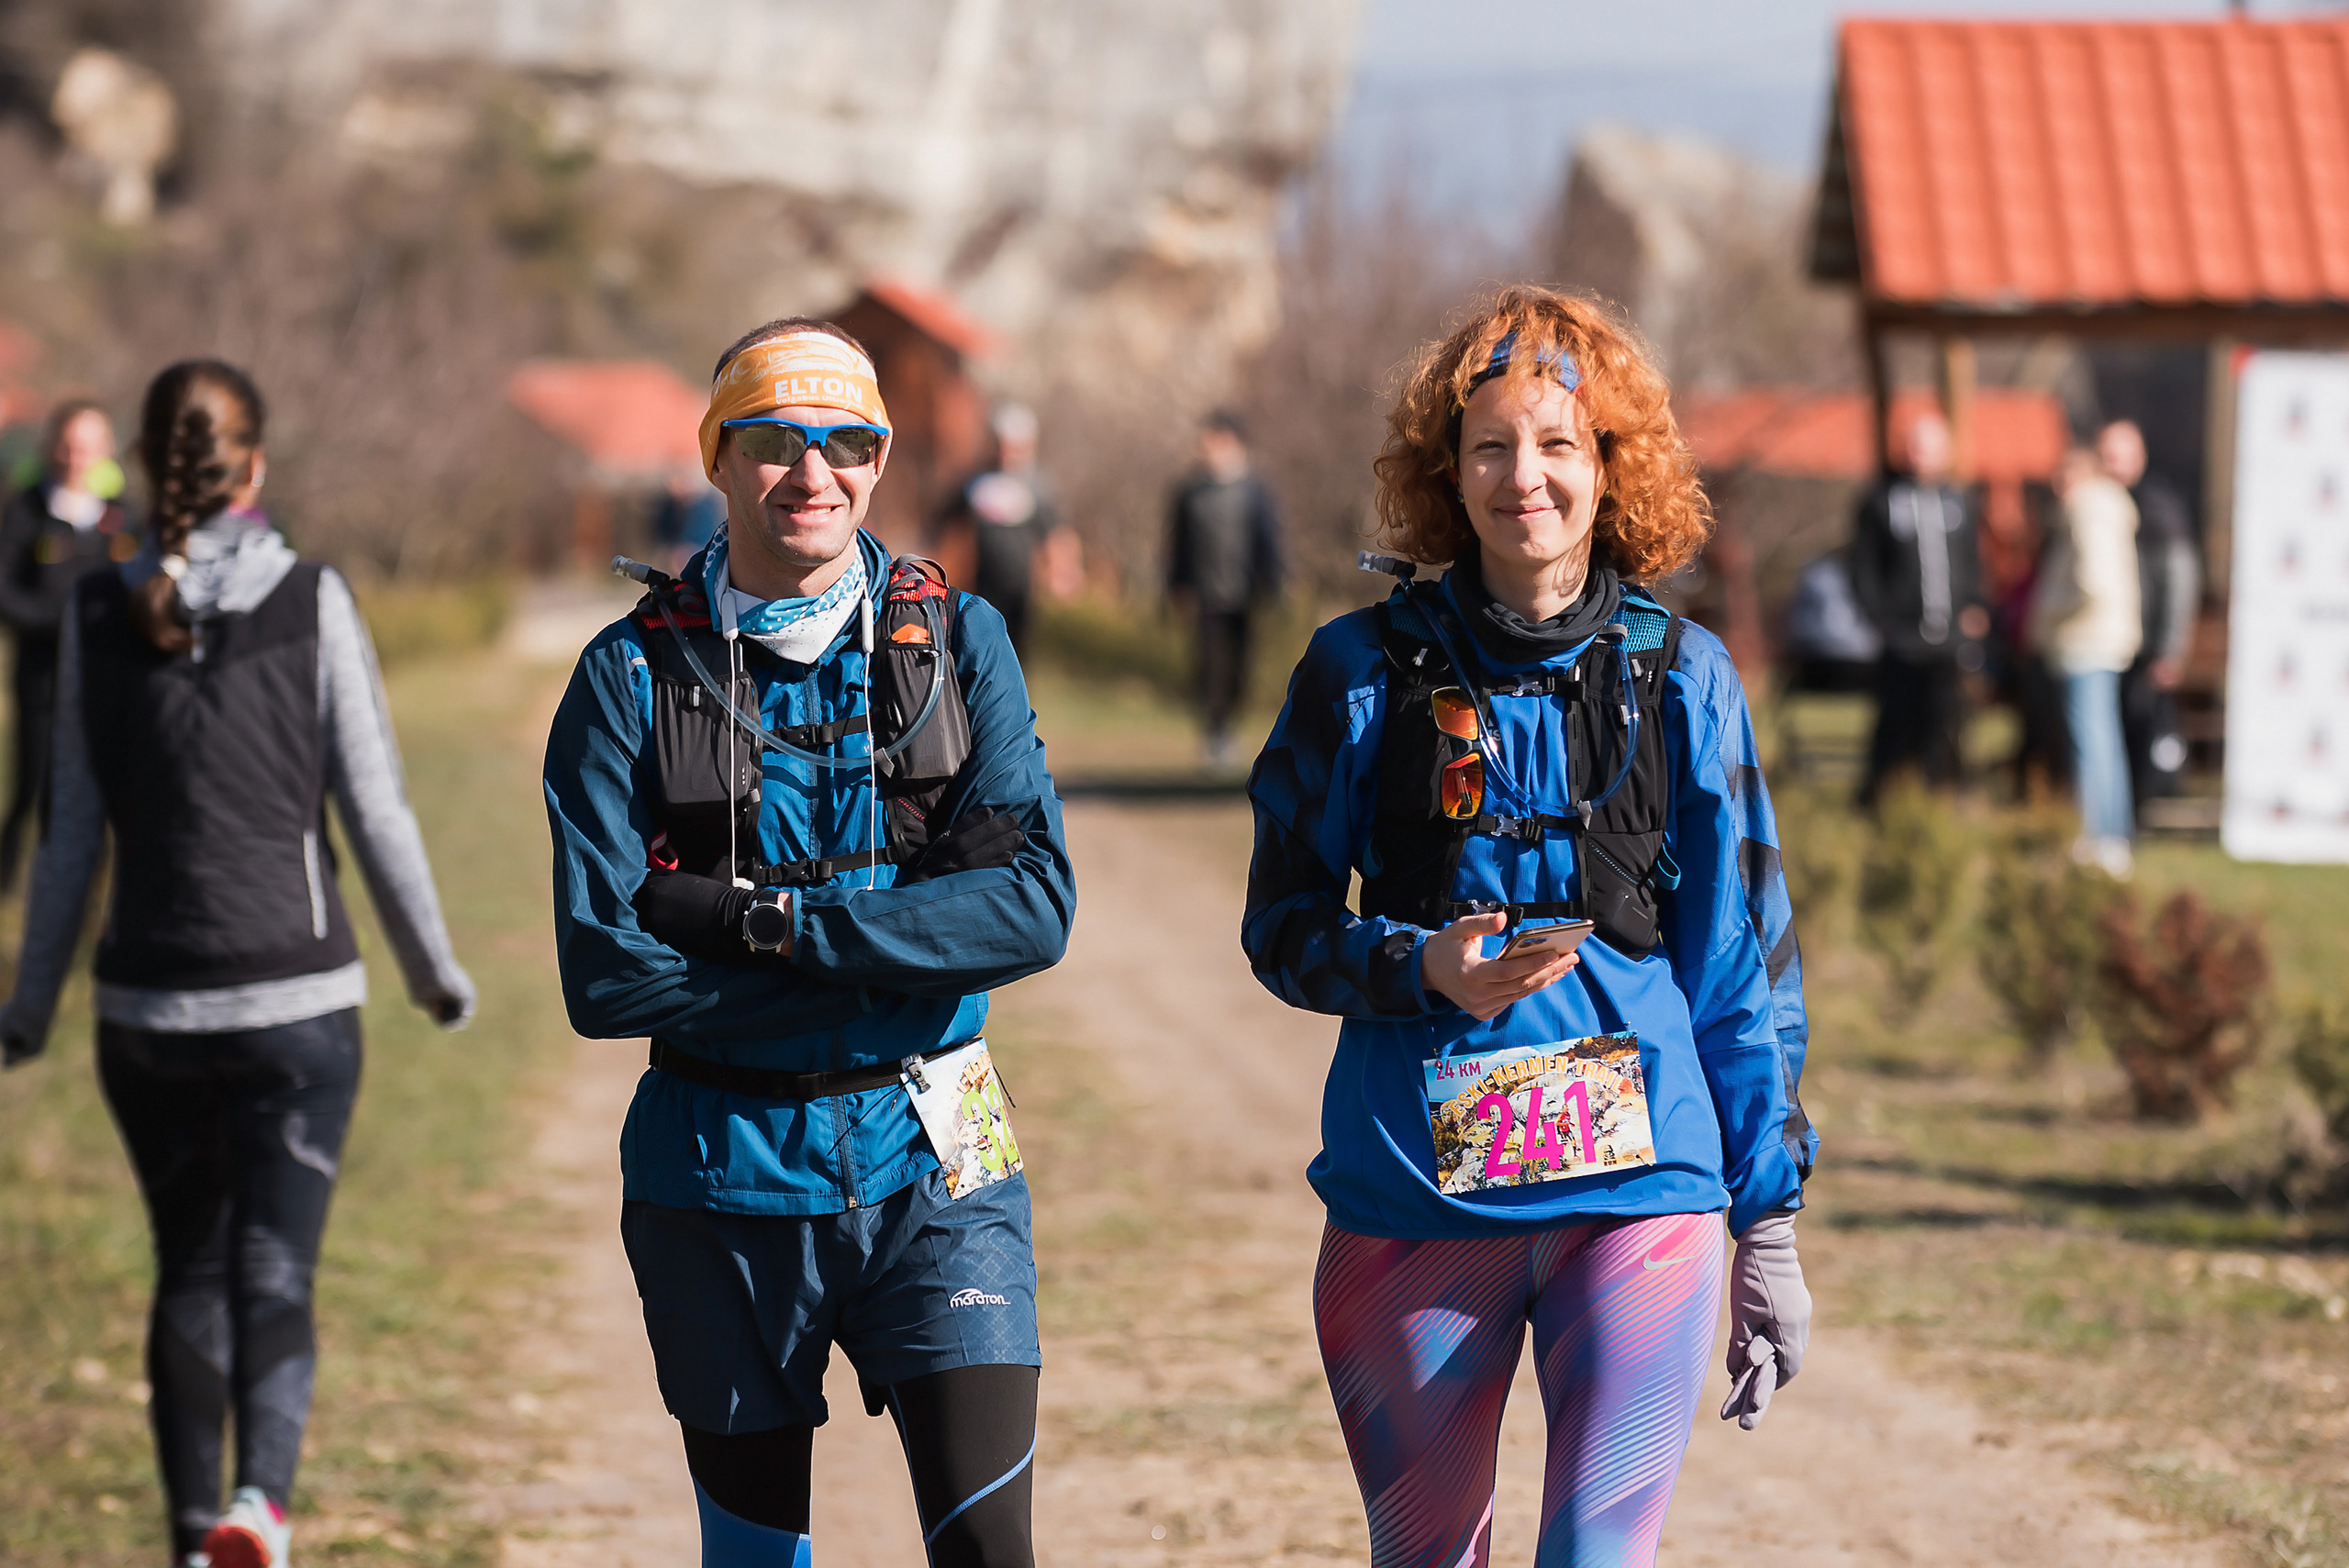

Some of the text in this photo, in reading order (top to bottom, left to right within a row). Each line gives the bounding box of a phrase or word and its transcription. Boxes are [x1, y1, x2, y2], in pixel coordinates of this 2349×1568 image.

[774, 376, 863, 404] ELTON
[775, 395, 819, 406] Volgabus
[1436, 1060, 1483, 1081] 24 KM
[1449, 1056, 1623, 1118] ESKI-KERMEN TRAIL
[1476, 1080, 1596, 1178] 241
[951, 1290, 1010, 1308] maraton
